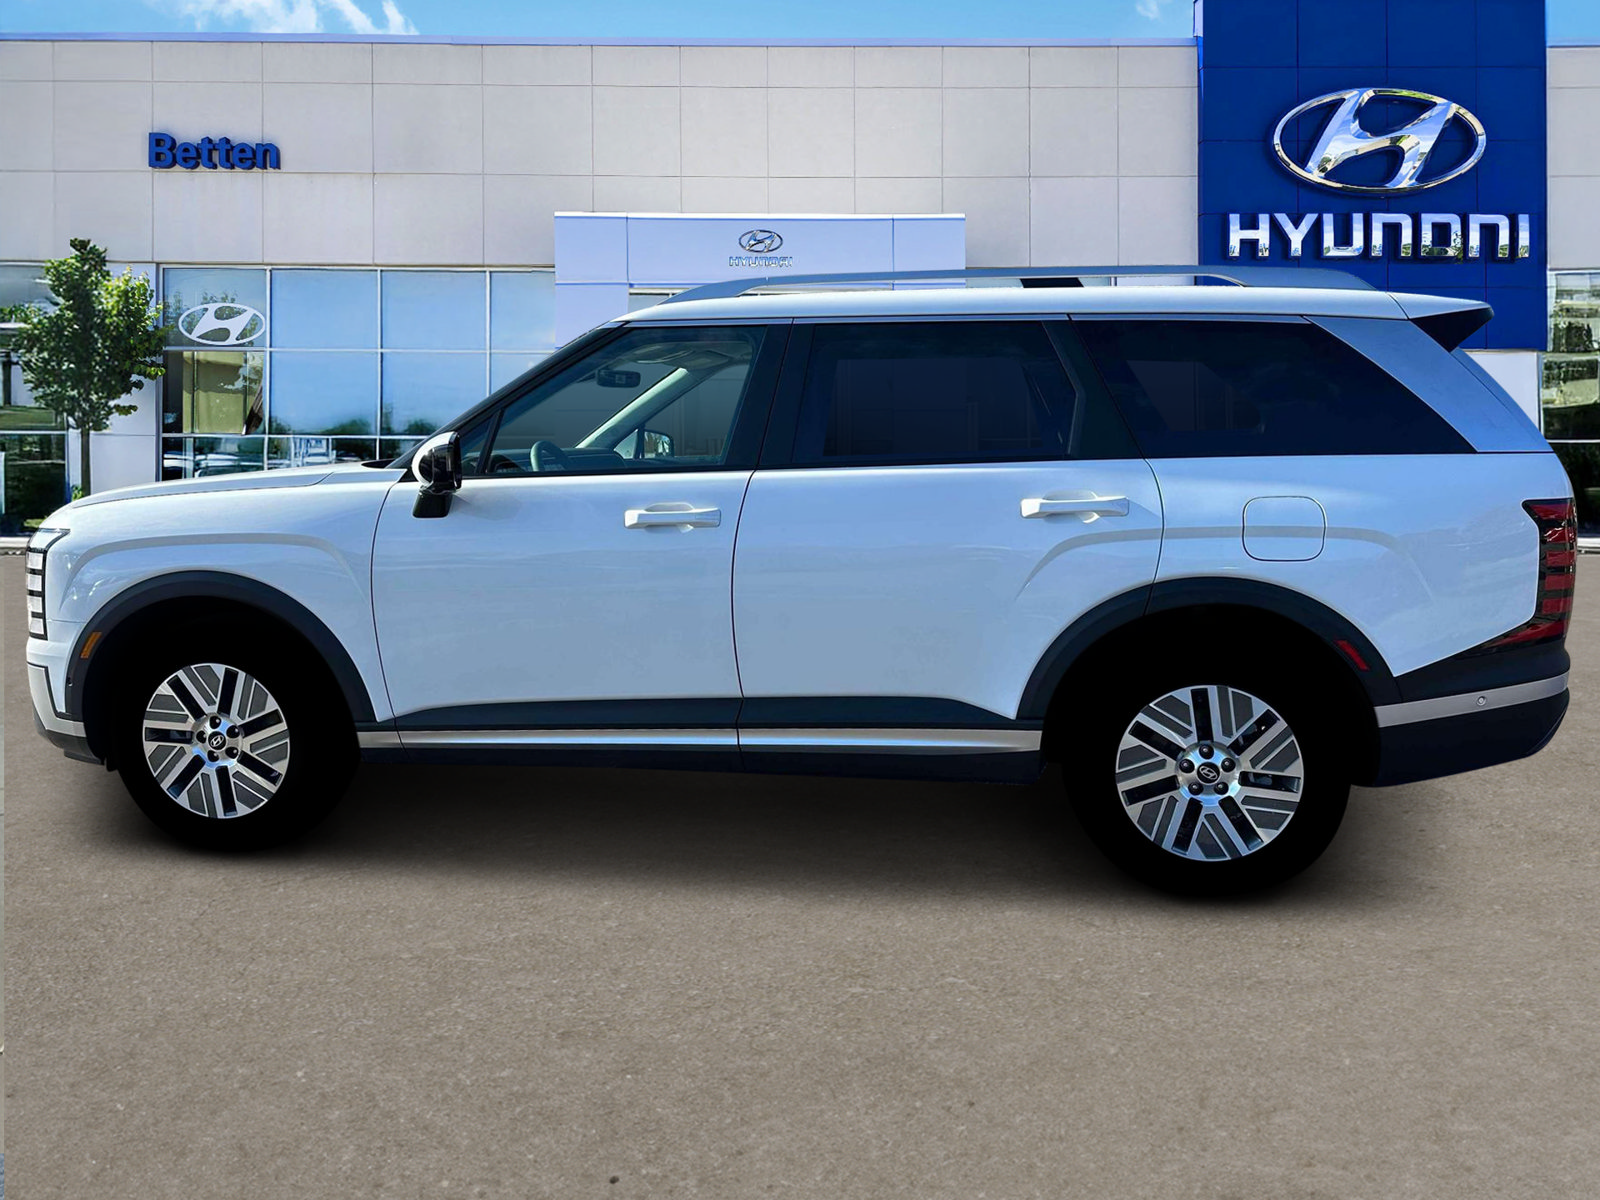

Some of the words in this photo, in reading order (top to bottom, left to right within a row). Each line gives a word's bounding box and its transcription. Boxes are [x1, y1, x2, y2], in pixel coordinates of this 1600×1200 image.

[148, 132, 281, 170] Betten
[1228, 212, 1530, 258] HYUNDAI
[728, 256, 793, 267] HYUNDAI
